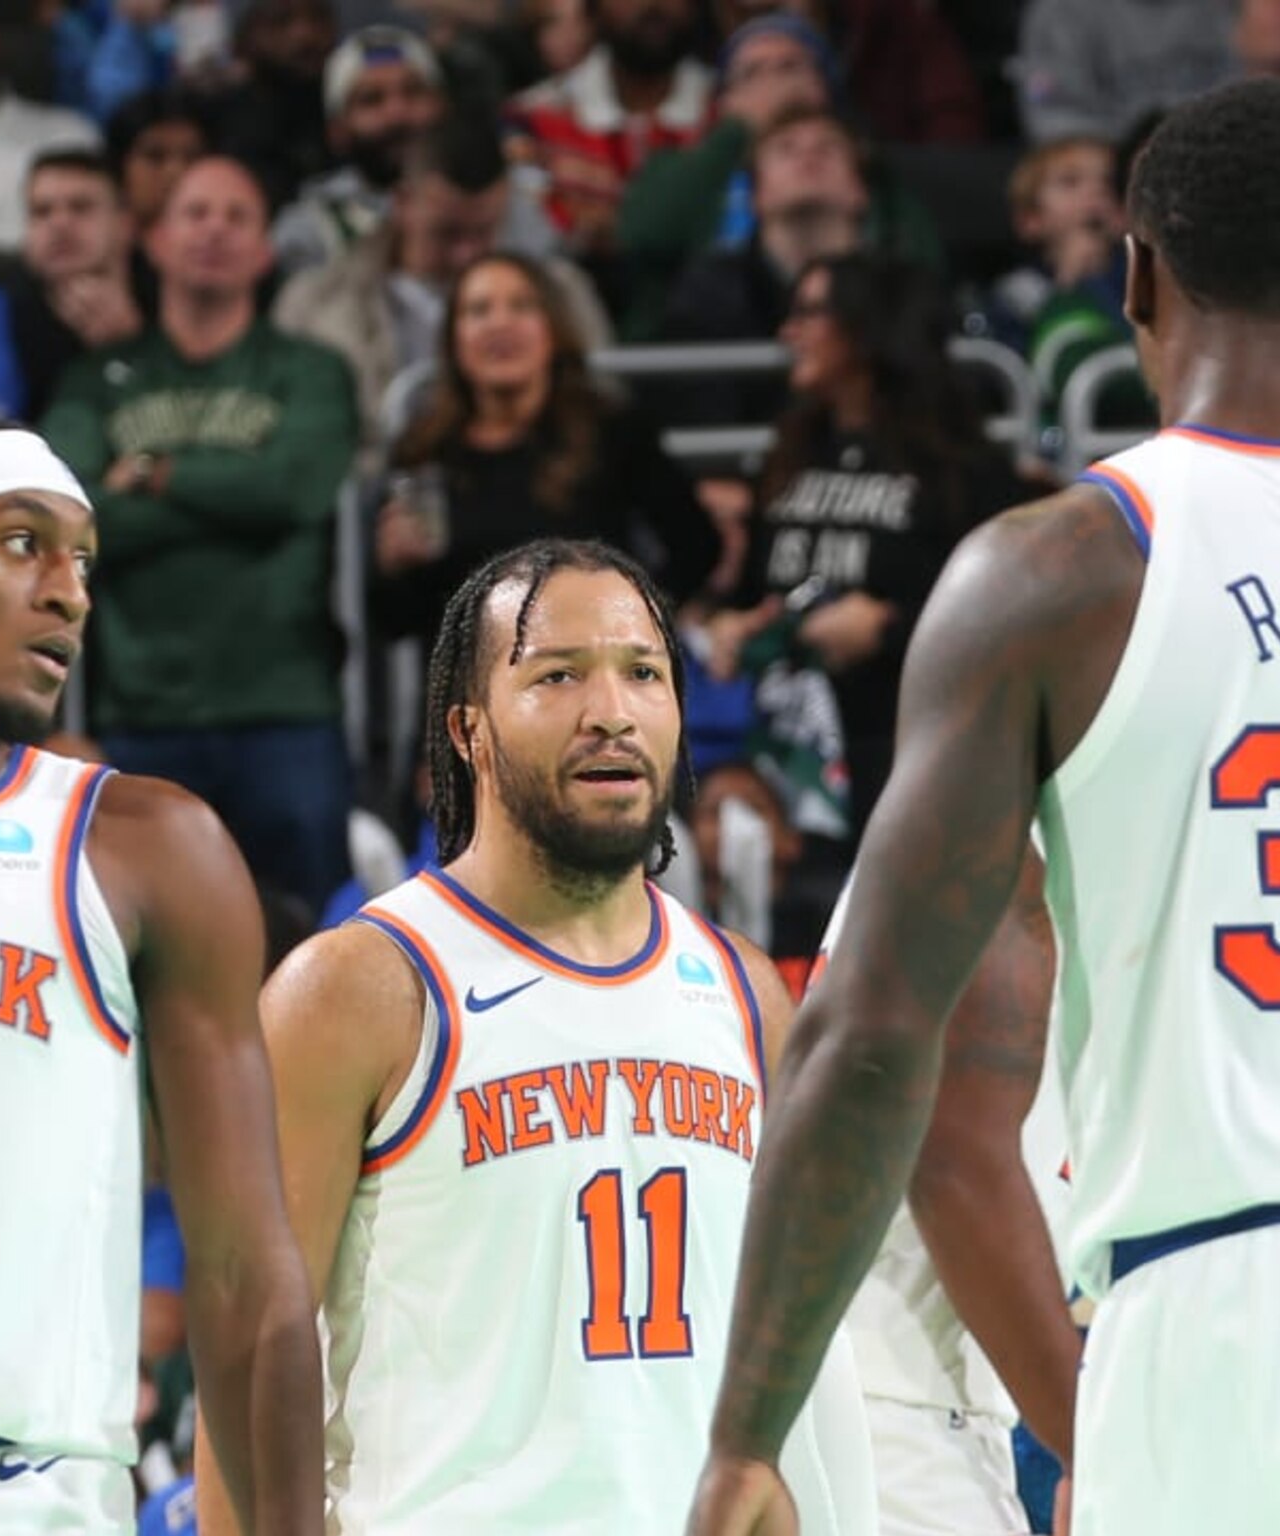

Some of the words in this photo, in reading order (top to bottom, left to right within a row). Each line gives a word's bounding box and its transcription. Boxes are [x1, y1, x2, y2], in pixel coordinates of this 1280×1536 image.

[456, 1058, 610, 1167] NEW
[616, 1058, 756, 1163] YORK
[577, 1166, 694, 1362] 11
